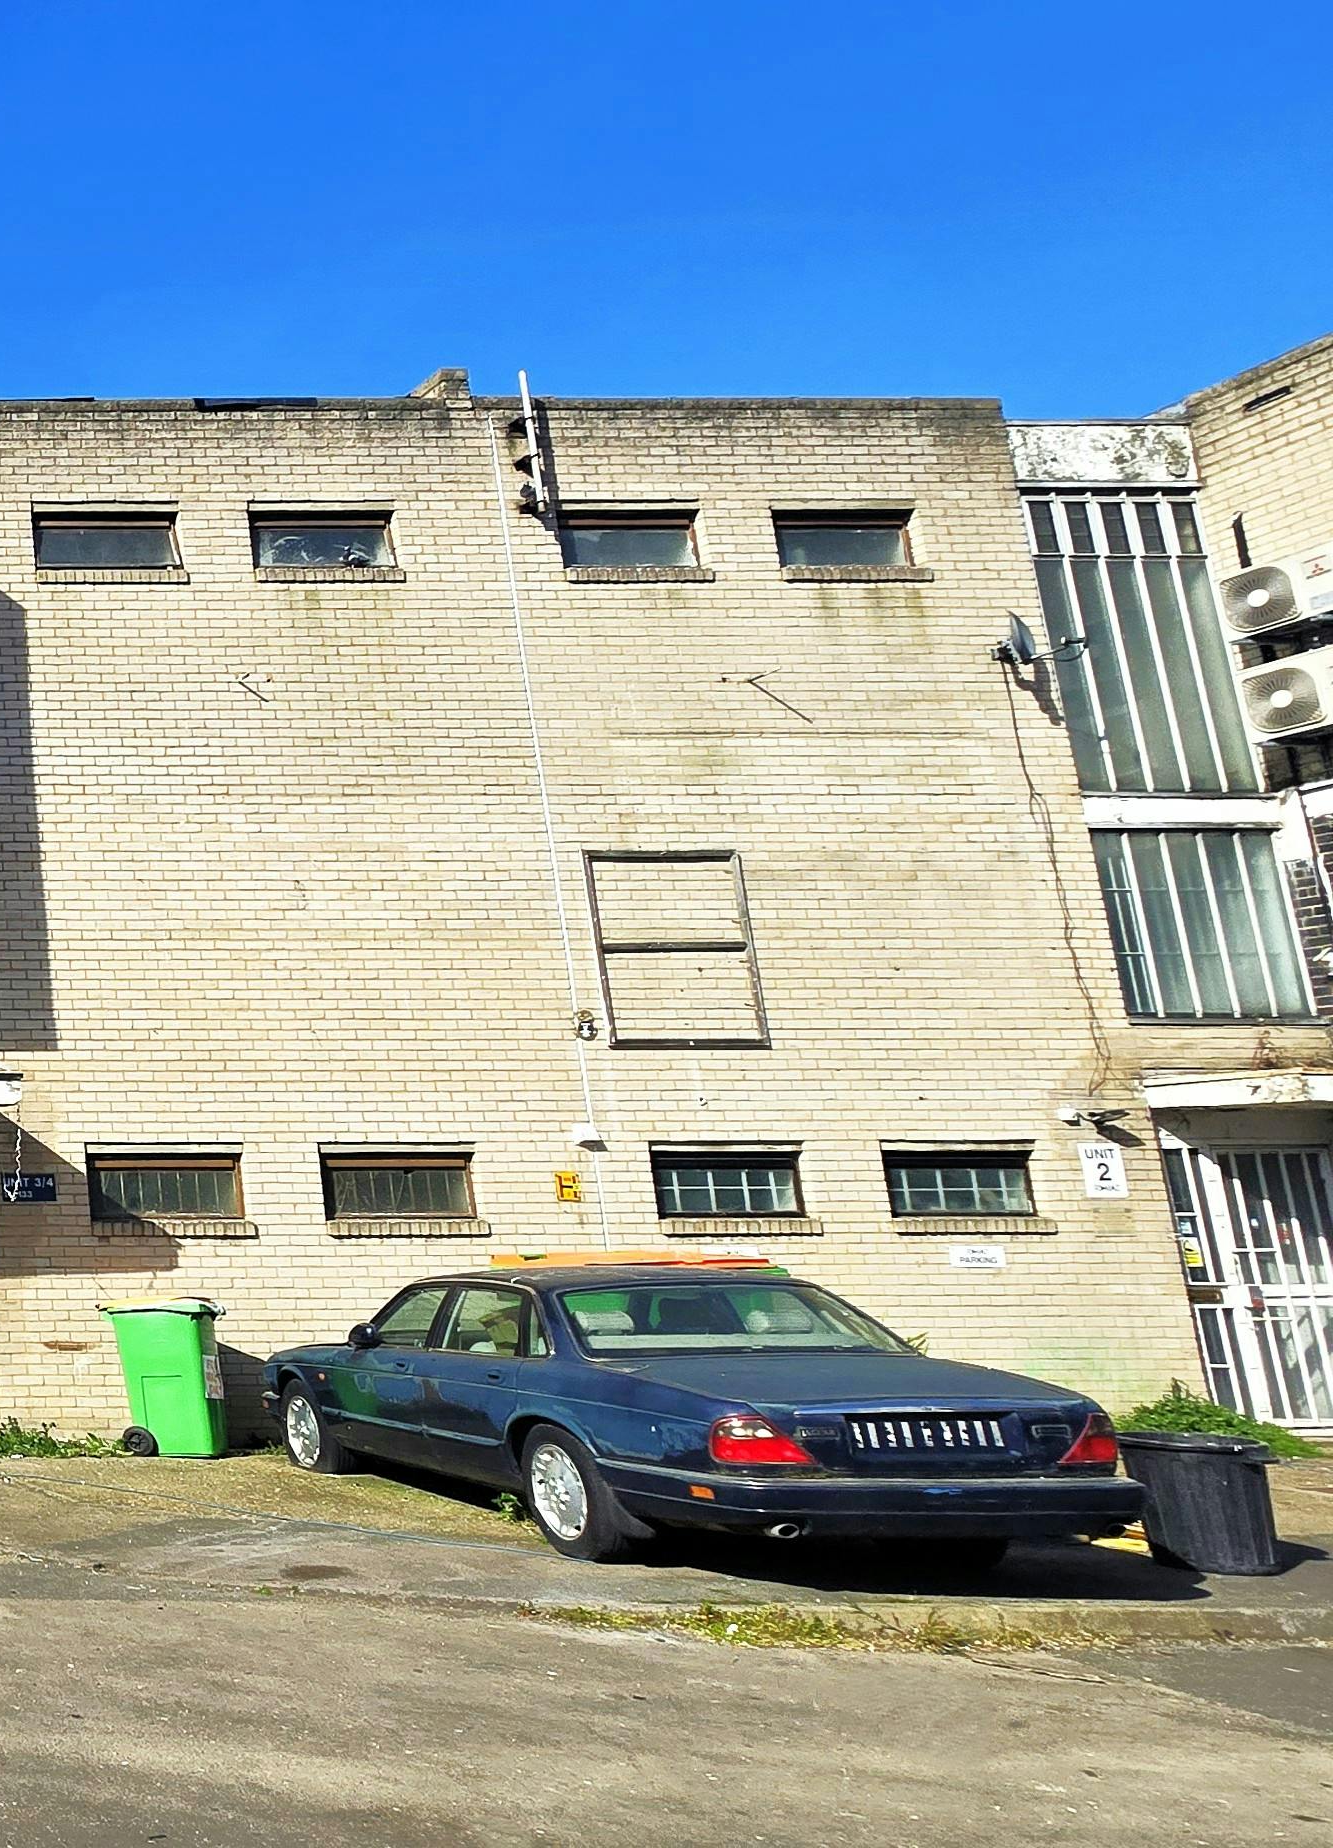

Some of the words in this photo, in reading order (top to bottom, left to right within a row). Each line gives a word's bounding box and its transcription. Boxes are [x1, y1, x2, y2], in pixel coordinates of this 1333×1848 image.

[1084, 1148, 1115, 1159] UNIT
[1096, 1162, 1113, 1181] 2
[34, 1176, 54, 1188] 3/4
